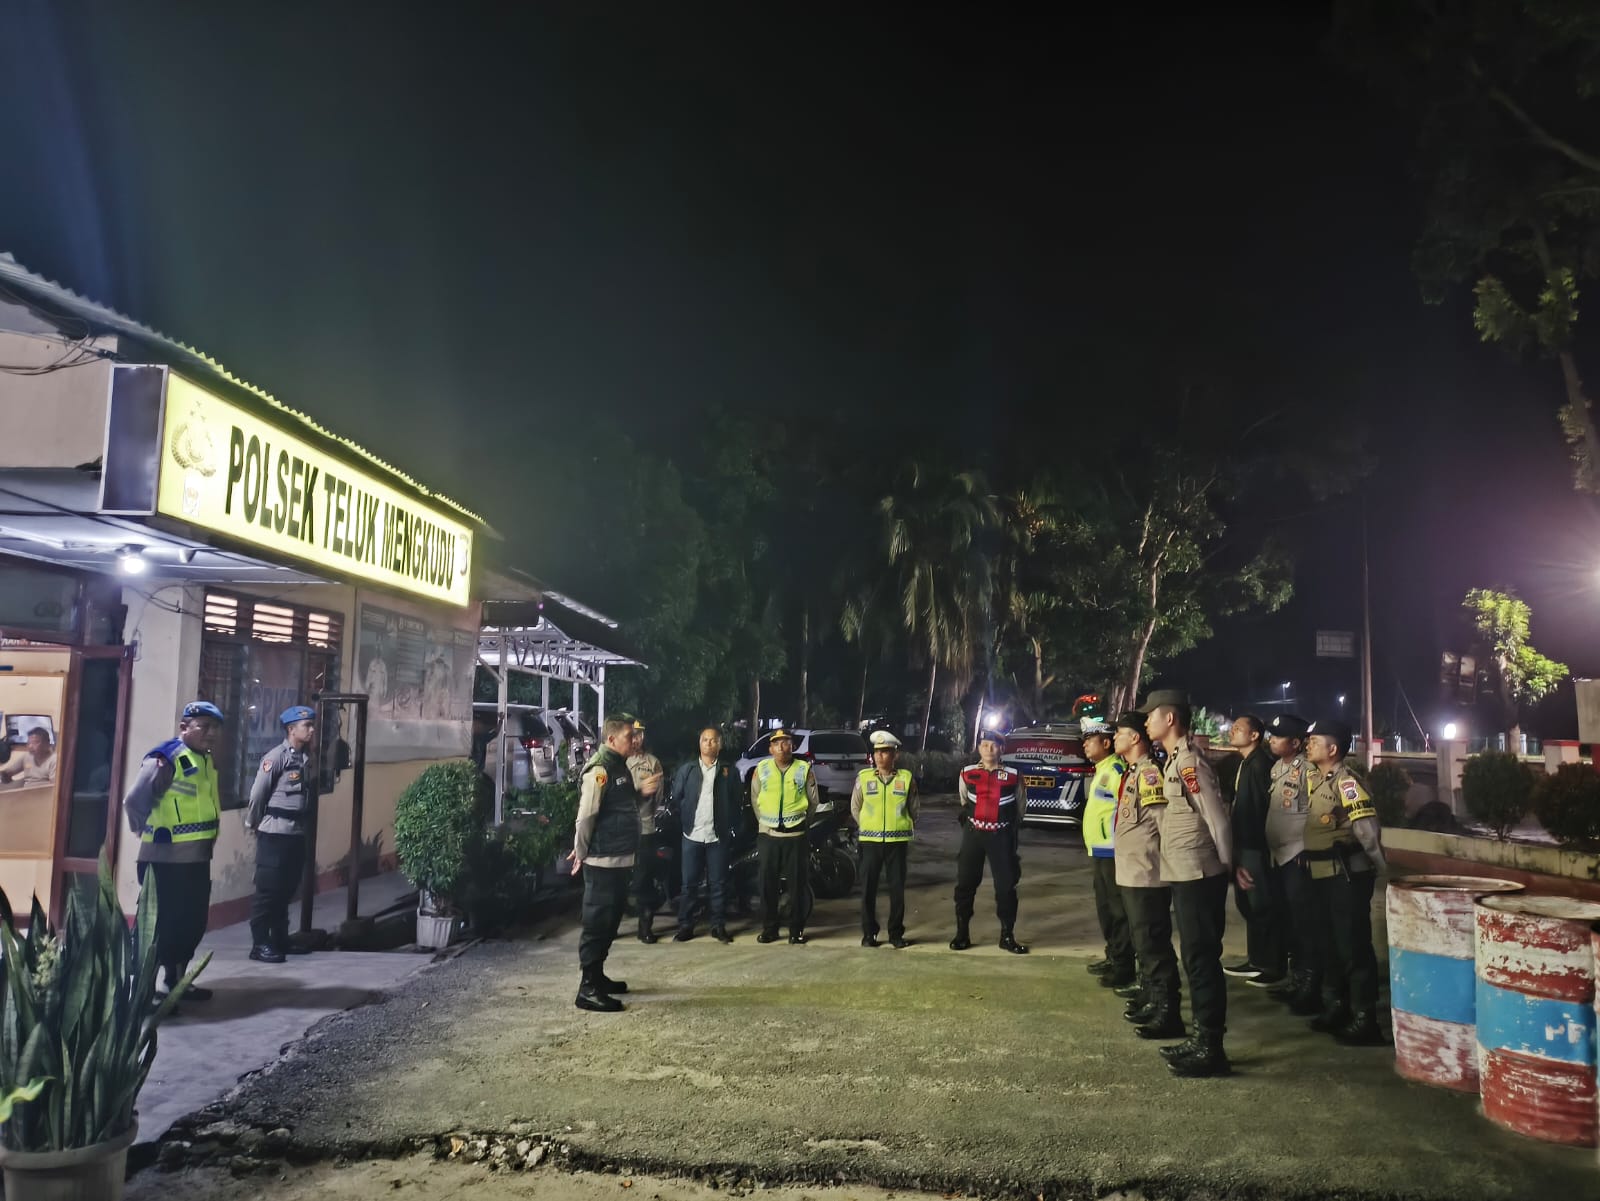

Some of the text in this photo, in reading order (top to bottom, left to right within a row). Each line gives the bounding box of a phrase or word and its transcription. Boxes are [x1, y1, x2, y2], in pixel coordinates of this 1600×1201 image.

[225, 426, 456, 591] POLSEK TELUK MENGKUDU
[1038, 747, 1064, 755] UNTUK
